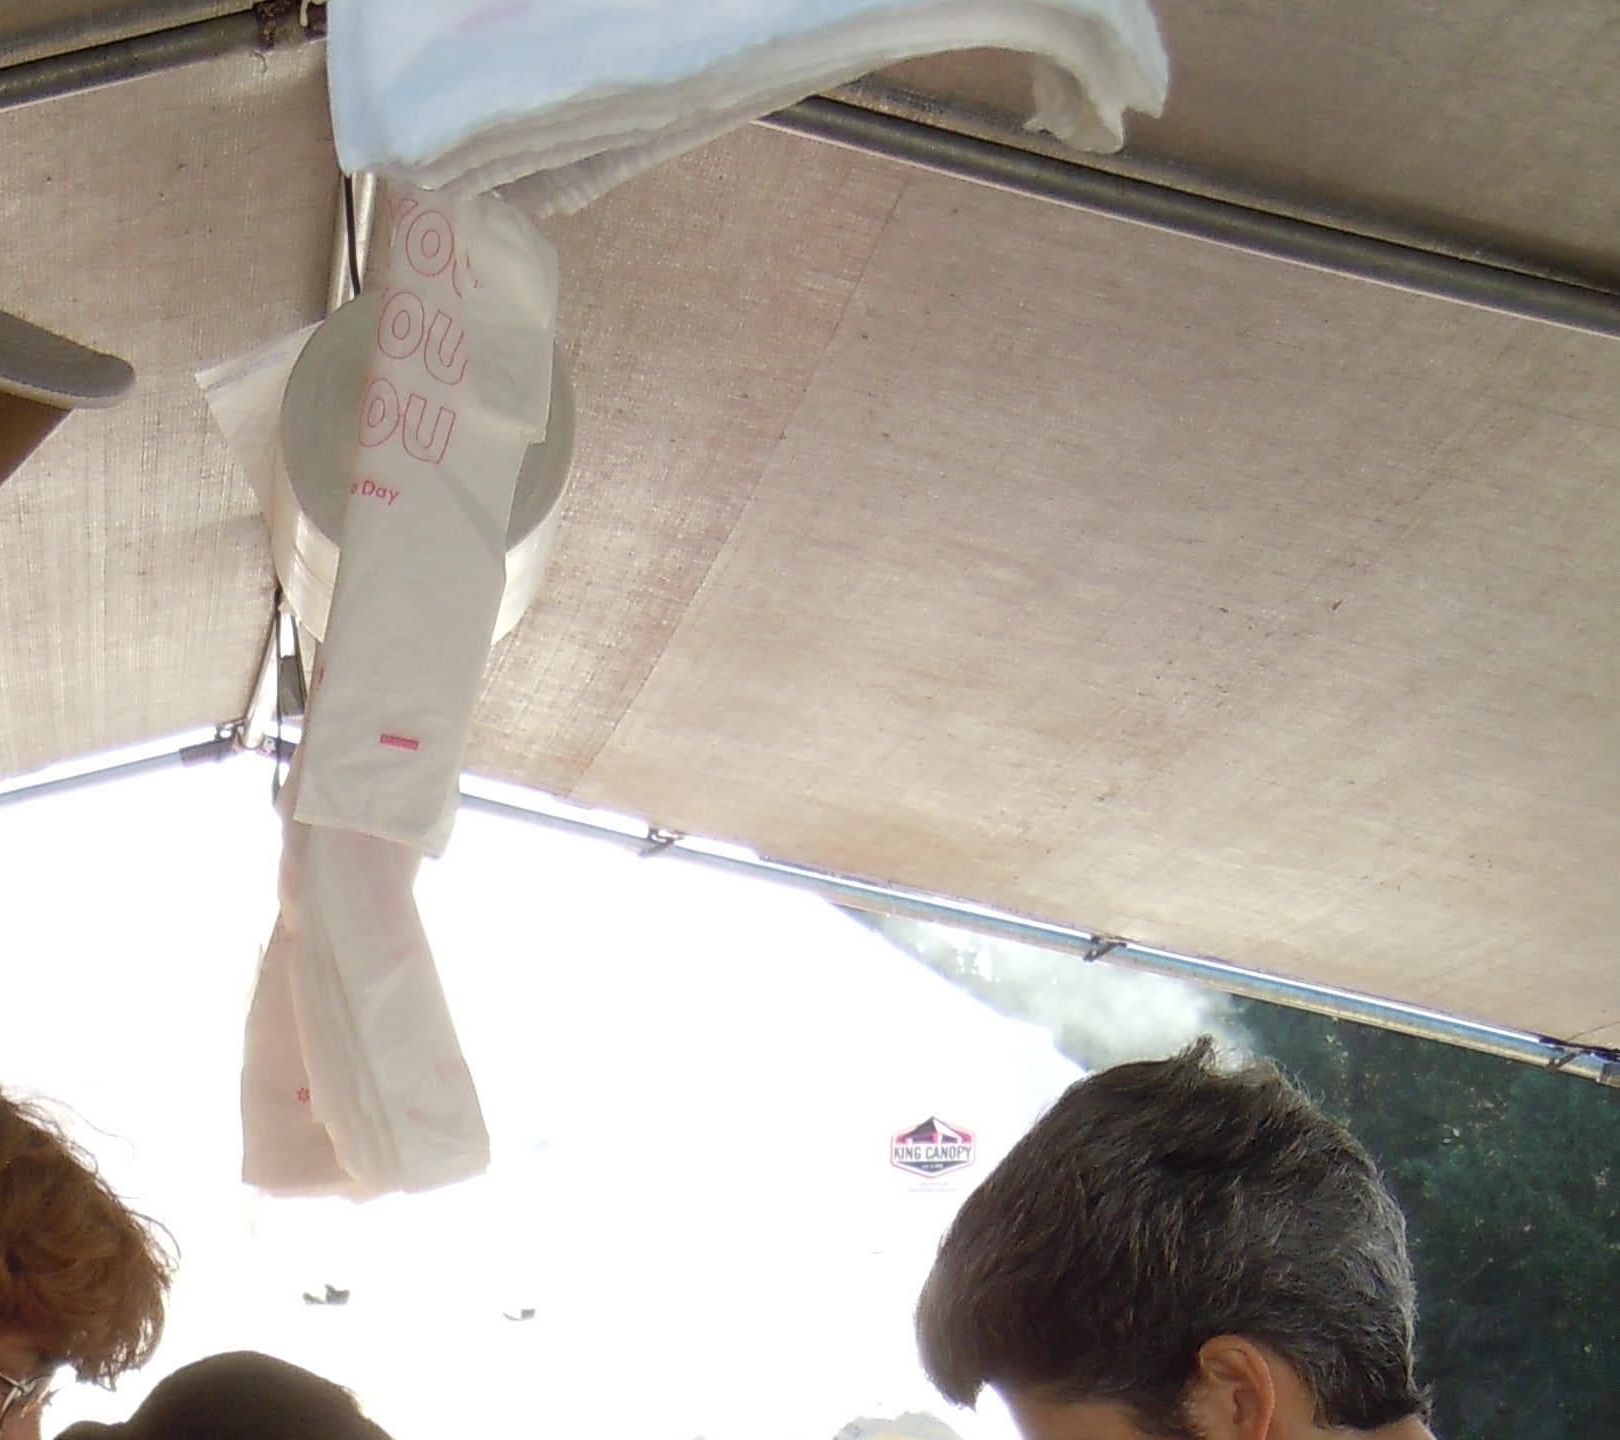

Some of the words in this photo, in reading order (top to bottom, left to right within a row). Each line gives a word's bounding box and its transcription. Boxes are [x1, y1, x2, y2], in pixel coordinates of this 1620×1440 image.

[361, 480, 399, 506] Day
[894, 1146, 921, 1160] KING
[925, 1146, 972, 1160] CANOPY
